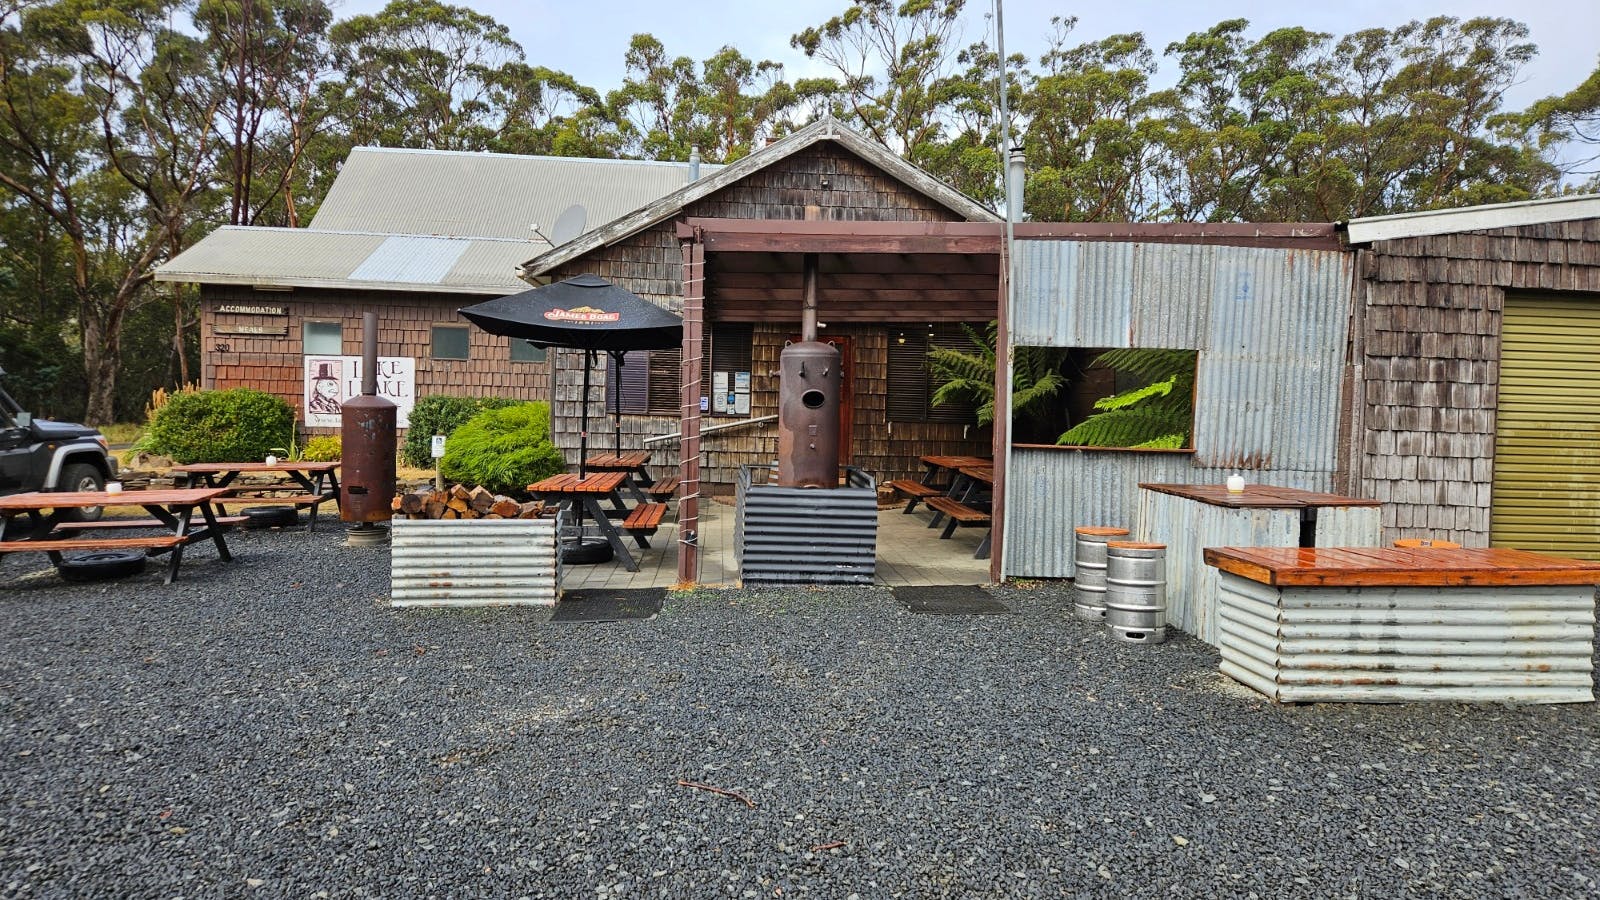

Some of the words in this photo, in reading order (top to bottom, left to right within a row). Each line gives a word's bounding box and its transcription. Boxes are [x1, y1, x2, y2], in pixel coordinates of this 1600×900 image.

[219, 305, 282, 315] ACCOMMODATION
[547, 310, 587, 320] JAMES
[238, 326, 264, 334] MEALS
[215, 343, 230, 352] 320
[353, 360, 403, 378] LKE
[348, 380, 409, 397] LKE
